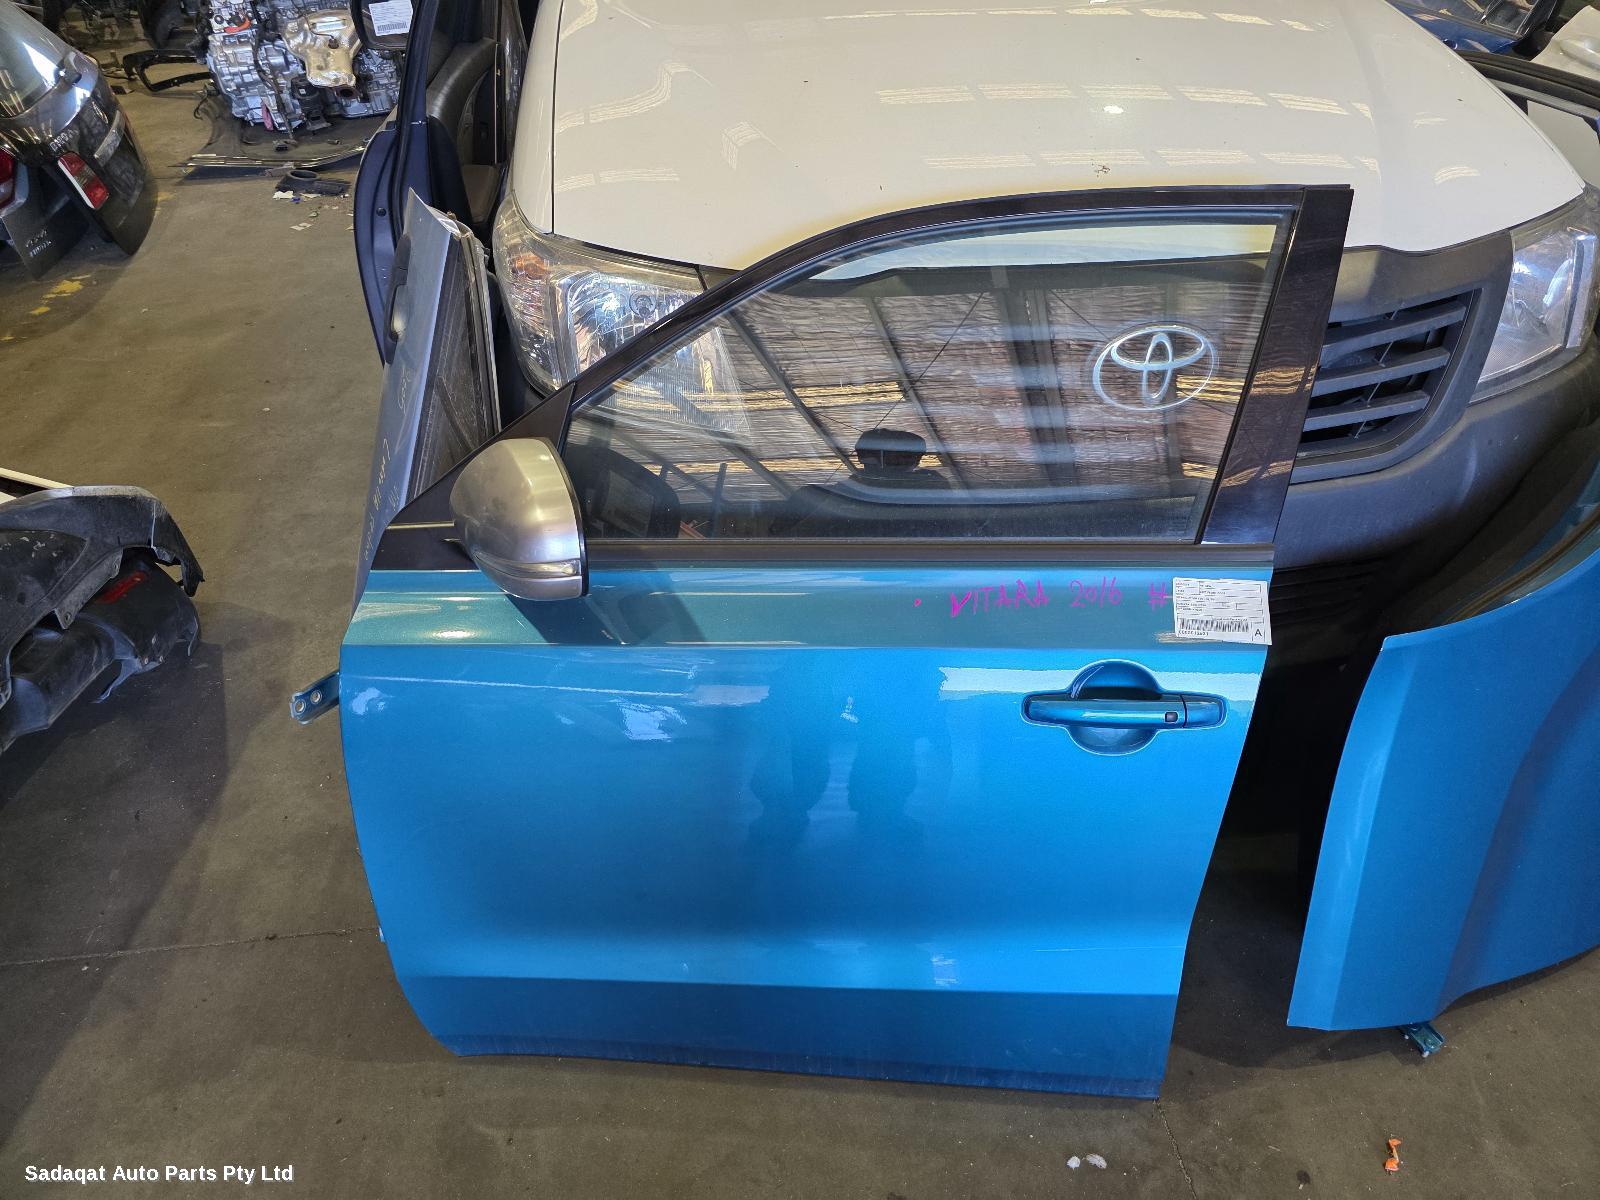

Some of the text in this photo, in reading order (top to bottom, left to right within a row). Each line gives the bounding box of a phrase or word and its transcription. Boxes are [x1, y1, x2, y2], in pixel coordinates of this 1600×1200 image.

[951, 579, 1049, 617] VITARA
[1070, 576, 1123, 609] 2016
[1254, 629, 1262, 637] A
